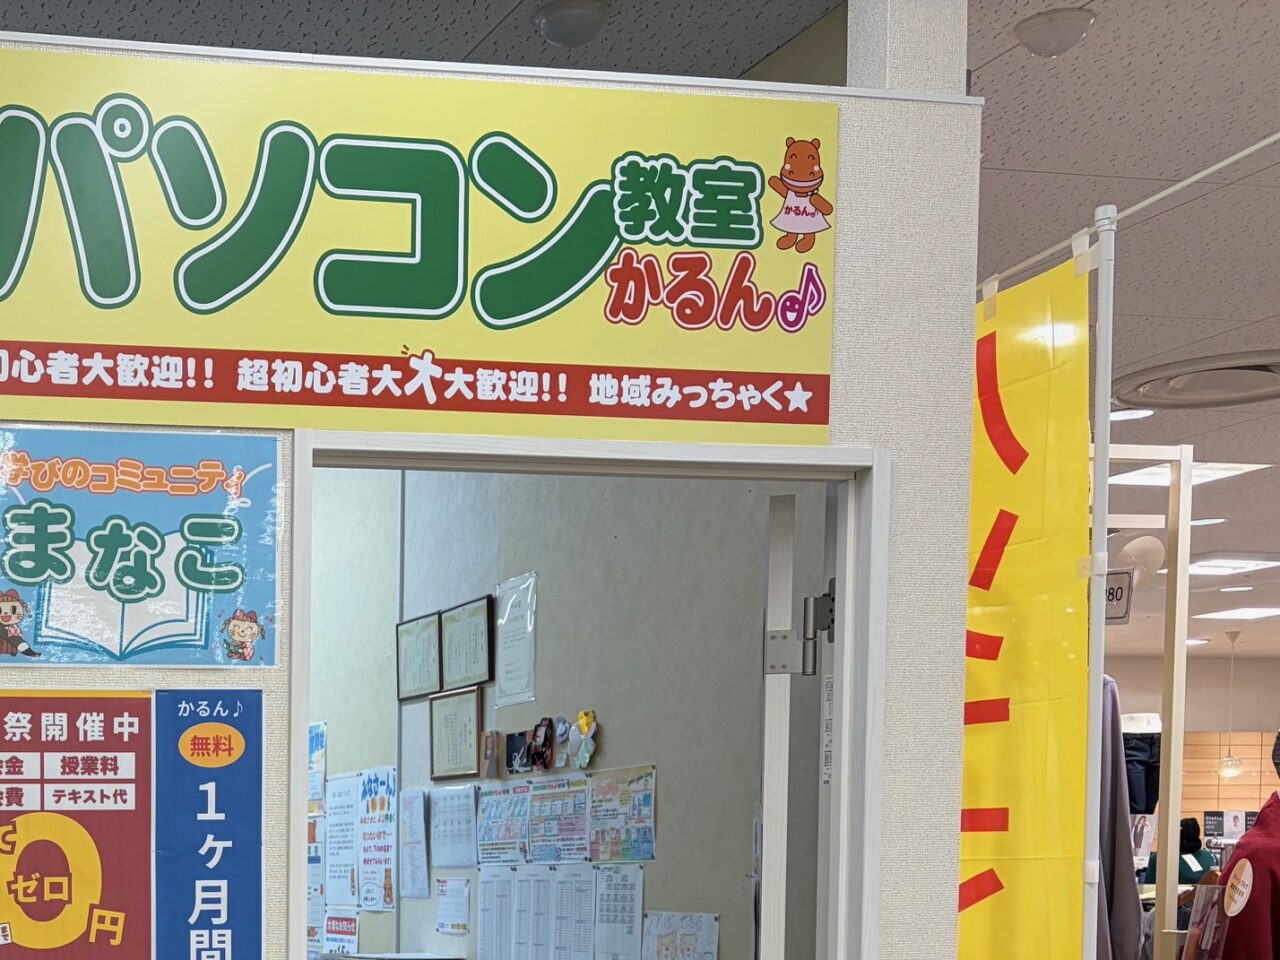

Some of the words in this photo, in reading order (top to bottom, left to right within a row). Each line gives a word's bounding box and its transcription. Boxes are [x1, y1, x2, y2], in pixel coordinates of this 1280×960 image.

[1, 498, 246, 603] まなこ
[1107, 587, 1123, 601] 80
[189, 734, 235, 758] 無料
[60, 755, 119, 776] 授業料
[51, 788, 128, 806] テキスト代
[10, 872, 70, 903] ゼロ
[88, 907, 125, 946] 円
